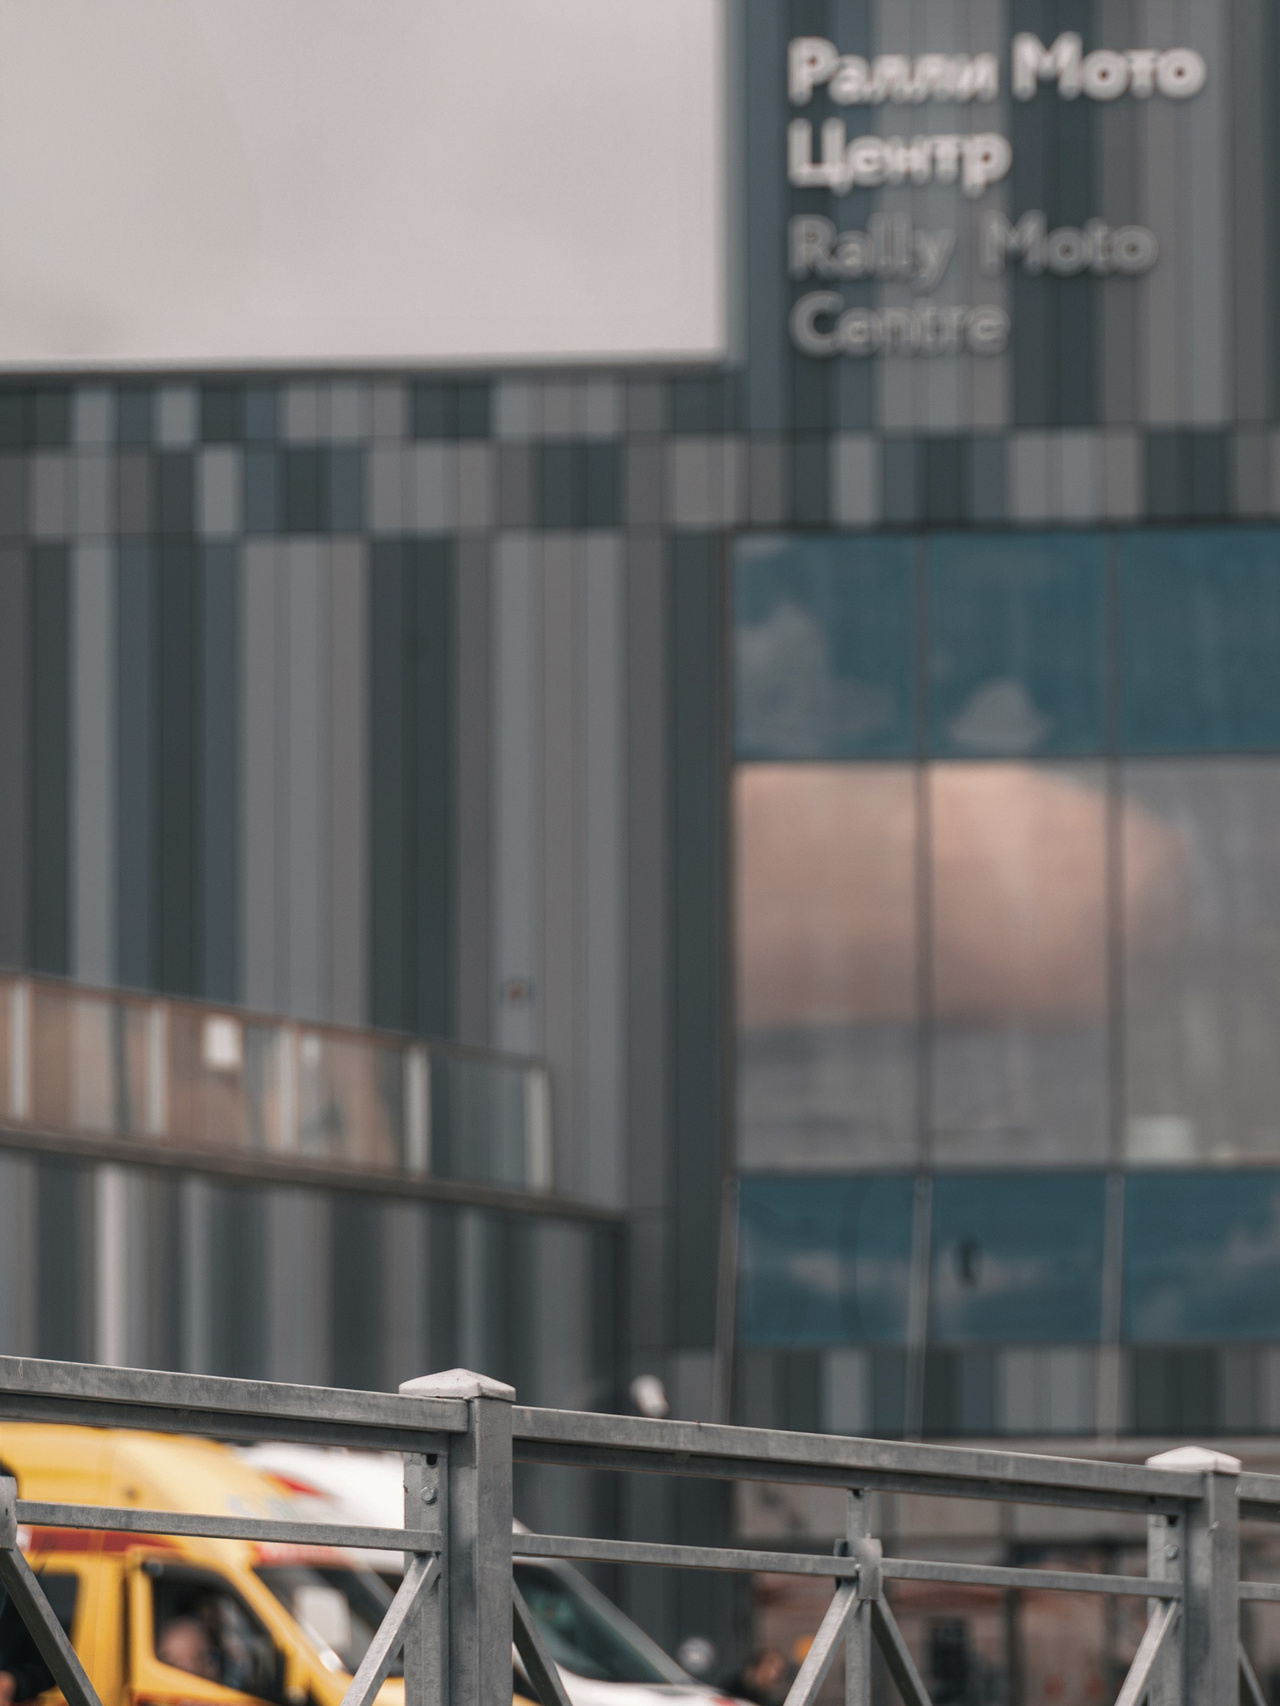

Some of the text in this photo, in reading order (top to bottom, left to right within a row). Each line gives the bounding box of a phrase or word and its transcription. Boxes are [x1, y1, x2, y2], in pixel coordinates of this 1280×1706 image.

[788, 30, 1208, 106] Ралли Мото
[787, 117, 1013, 197] Центр
[788, 208, 1159, 291] Rally Moto
[789, 289, 1011, 360] Centre
